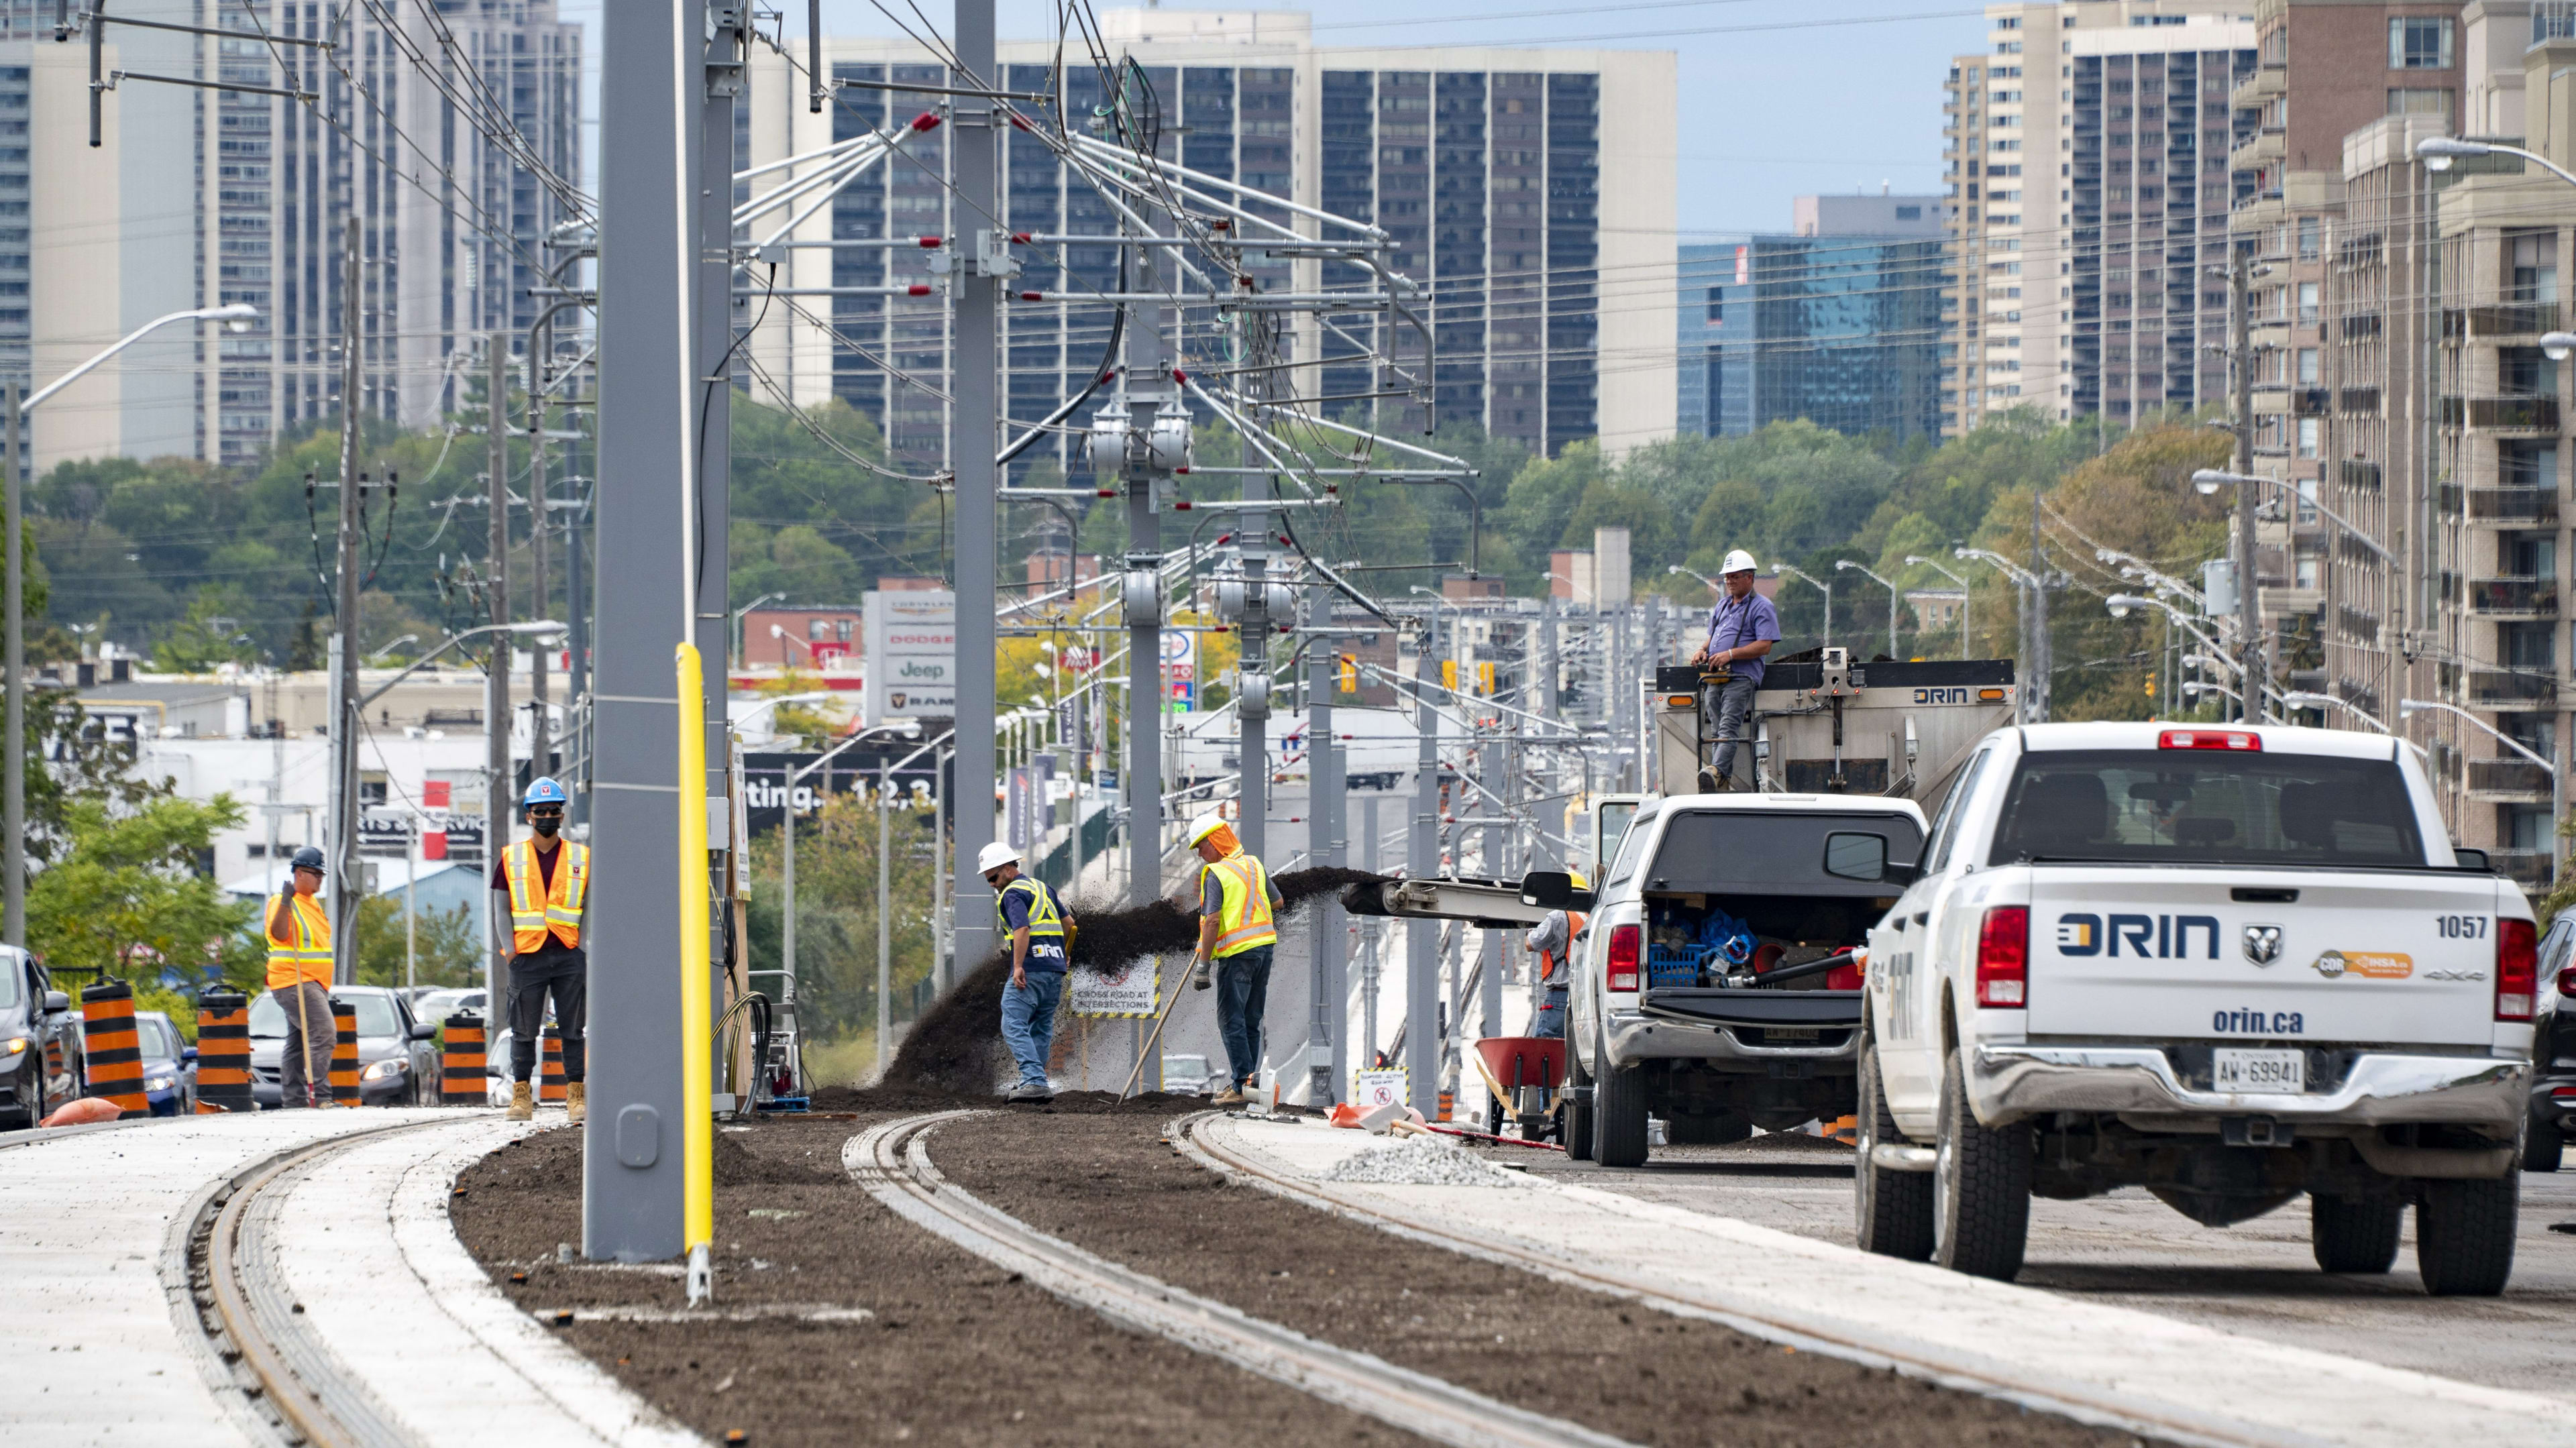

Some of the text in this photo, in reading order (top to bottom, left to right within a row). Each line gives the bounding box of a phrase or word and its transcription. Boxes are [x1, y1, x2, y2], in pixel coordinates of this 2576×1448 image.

[890, 635, 955, 644] DODGE
[900, 661, 945, 679] Jeep
[910, 698, 955, 706] RAM
[1914, 688, 1967, 704] ORIN
[2436, 915, 2487, 939] 1057
[2057, 913, 2220, 960] ORIN
[2319, 957, 2345, 972] COR
[1110, 991, 1135, 999] ROAD
[1138, 991, 1148, 999] AT
[2213, 1007, 2304, 1034] orin.ca
